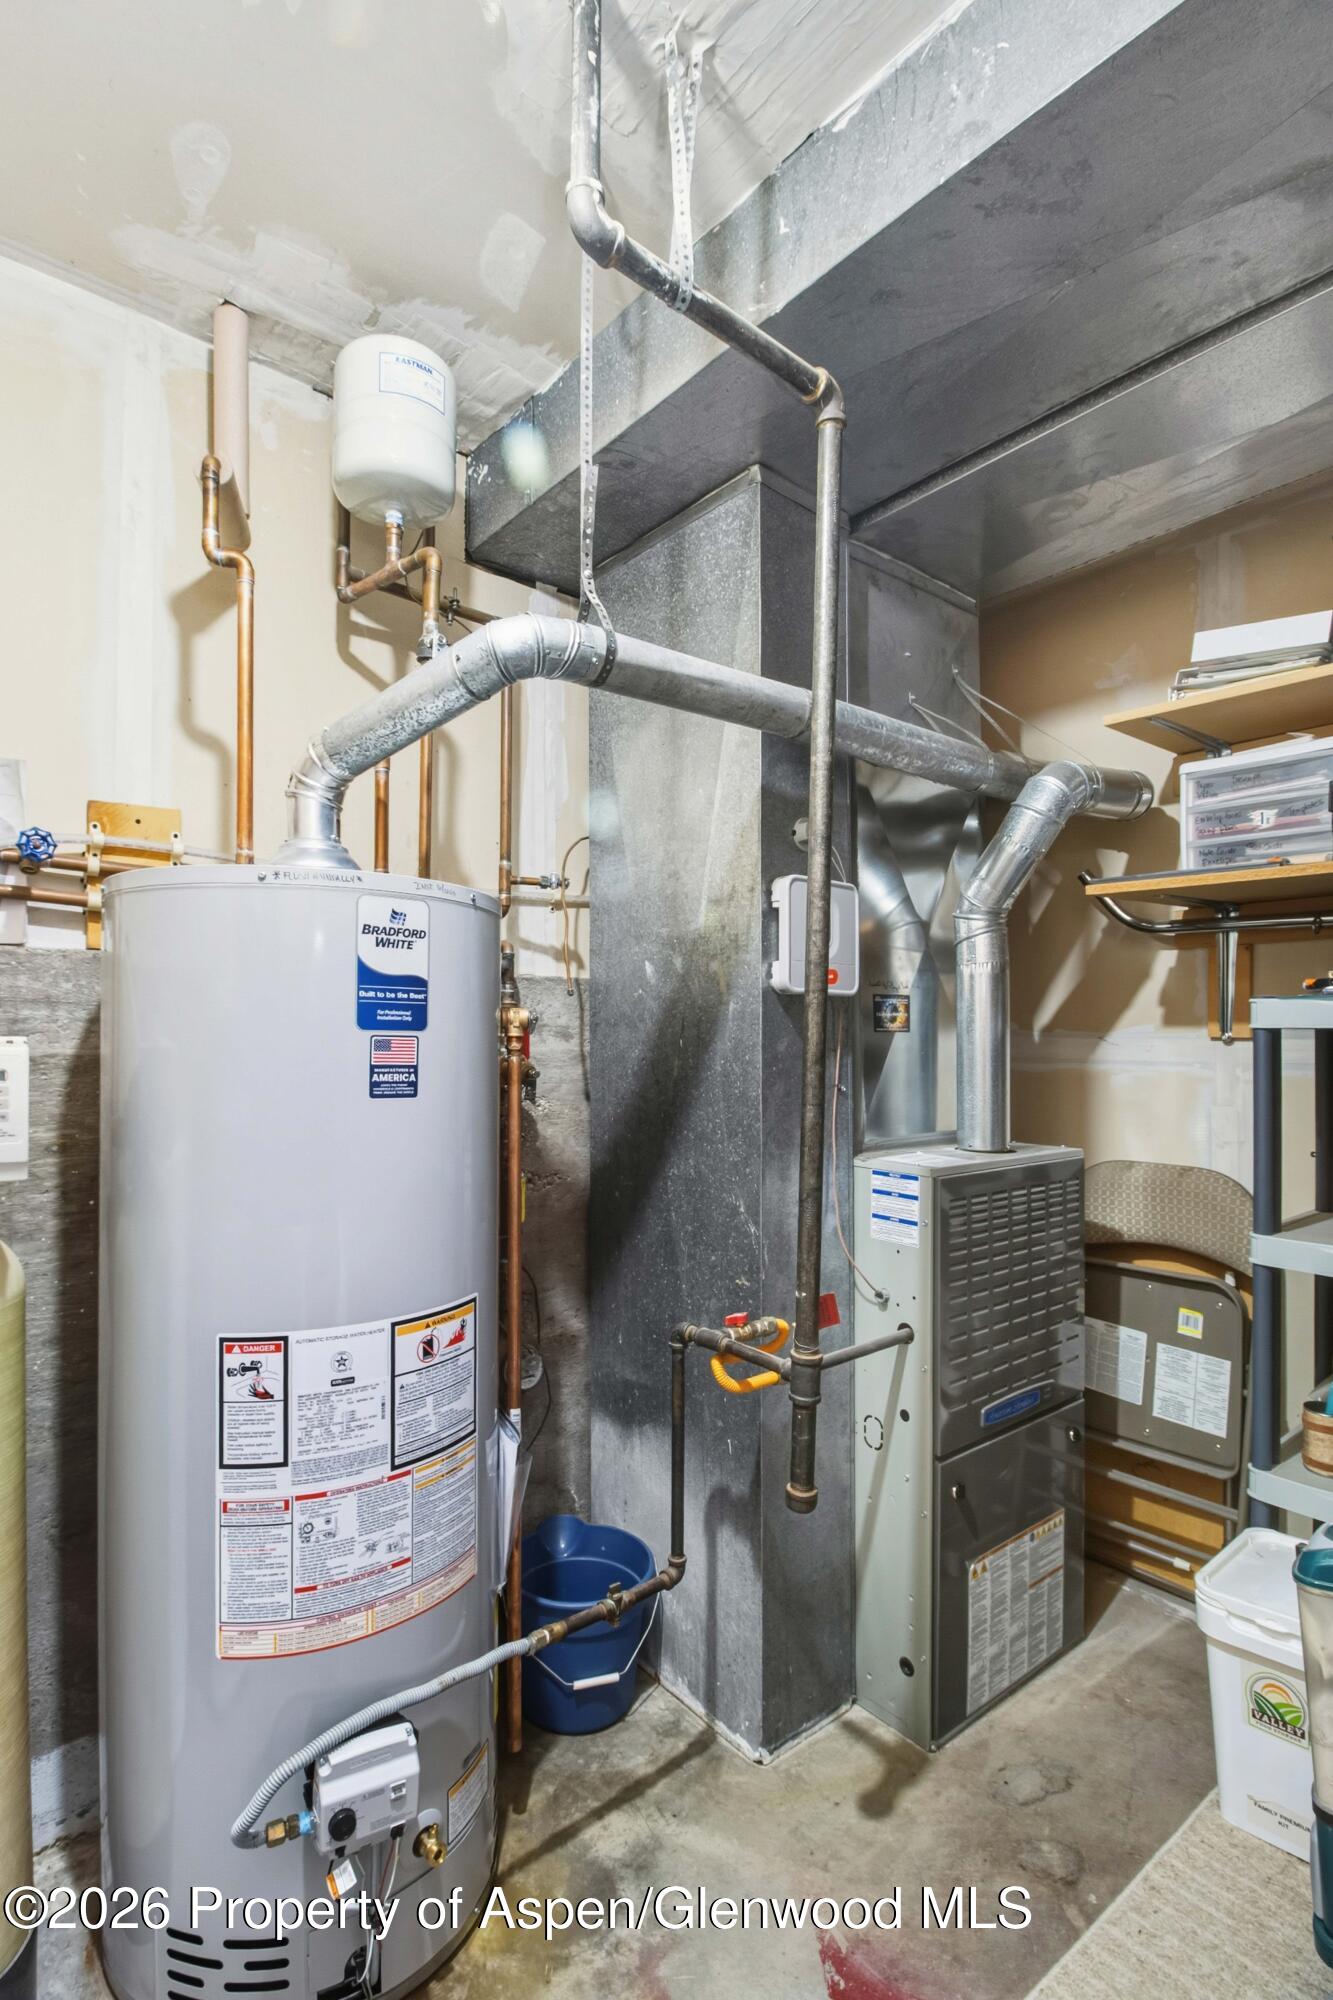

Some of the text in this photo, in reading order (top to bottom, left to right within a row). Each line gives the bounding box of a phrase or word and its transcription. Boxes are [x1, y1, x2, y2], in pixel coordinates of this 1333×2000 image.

[395, 356, 433, 375] EASTMAN
[362, 924, 427, 940] BRADFORD
[375, 937, 414, 950] WHITE
[359, 990, 376, 998] Built
[372, 1073, 416, 1082] AMERICA
[1253, 1709, 1304, 1737] VALLEY
[1253, 1800, 1278, 1817] FAMILY
